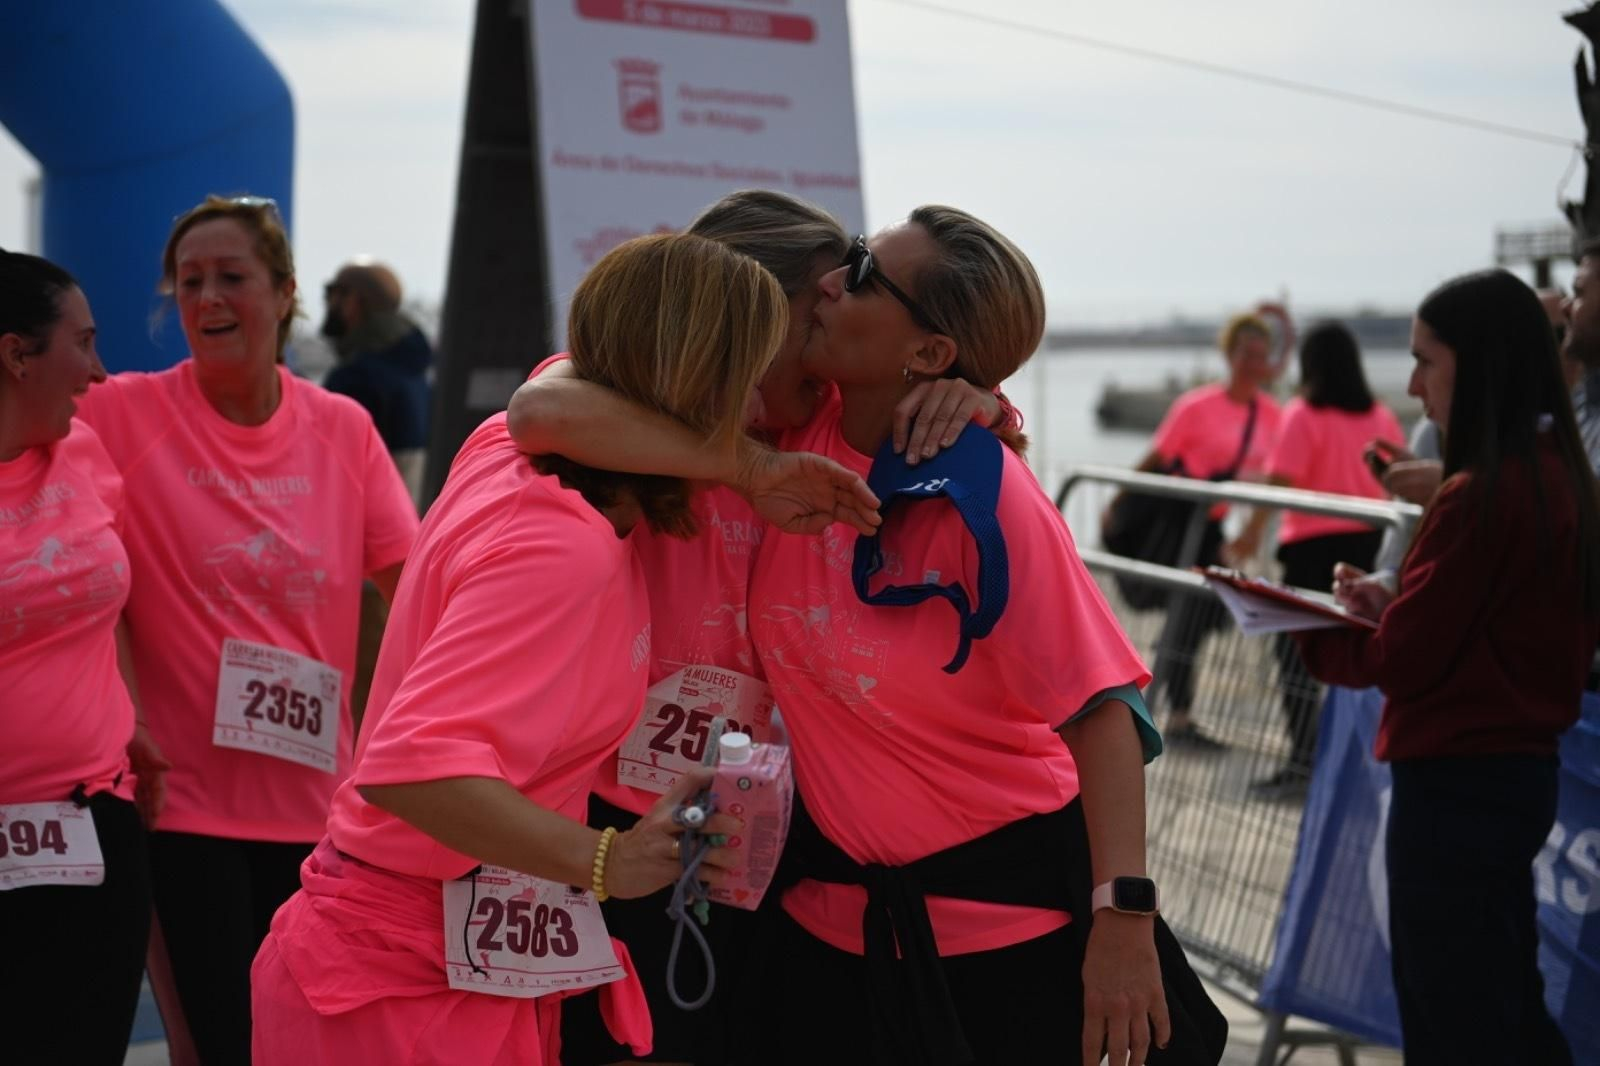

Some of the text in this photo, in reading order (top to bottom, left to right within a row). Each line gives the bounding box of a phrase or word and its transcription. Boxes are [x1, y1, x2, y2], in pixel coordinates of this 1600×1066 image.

[691, 668, 738, 689] MUJERES
[244, 680, 322, 737] 2353
[476, 896, 579, 958] 2583
